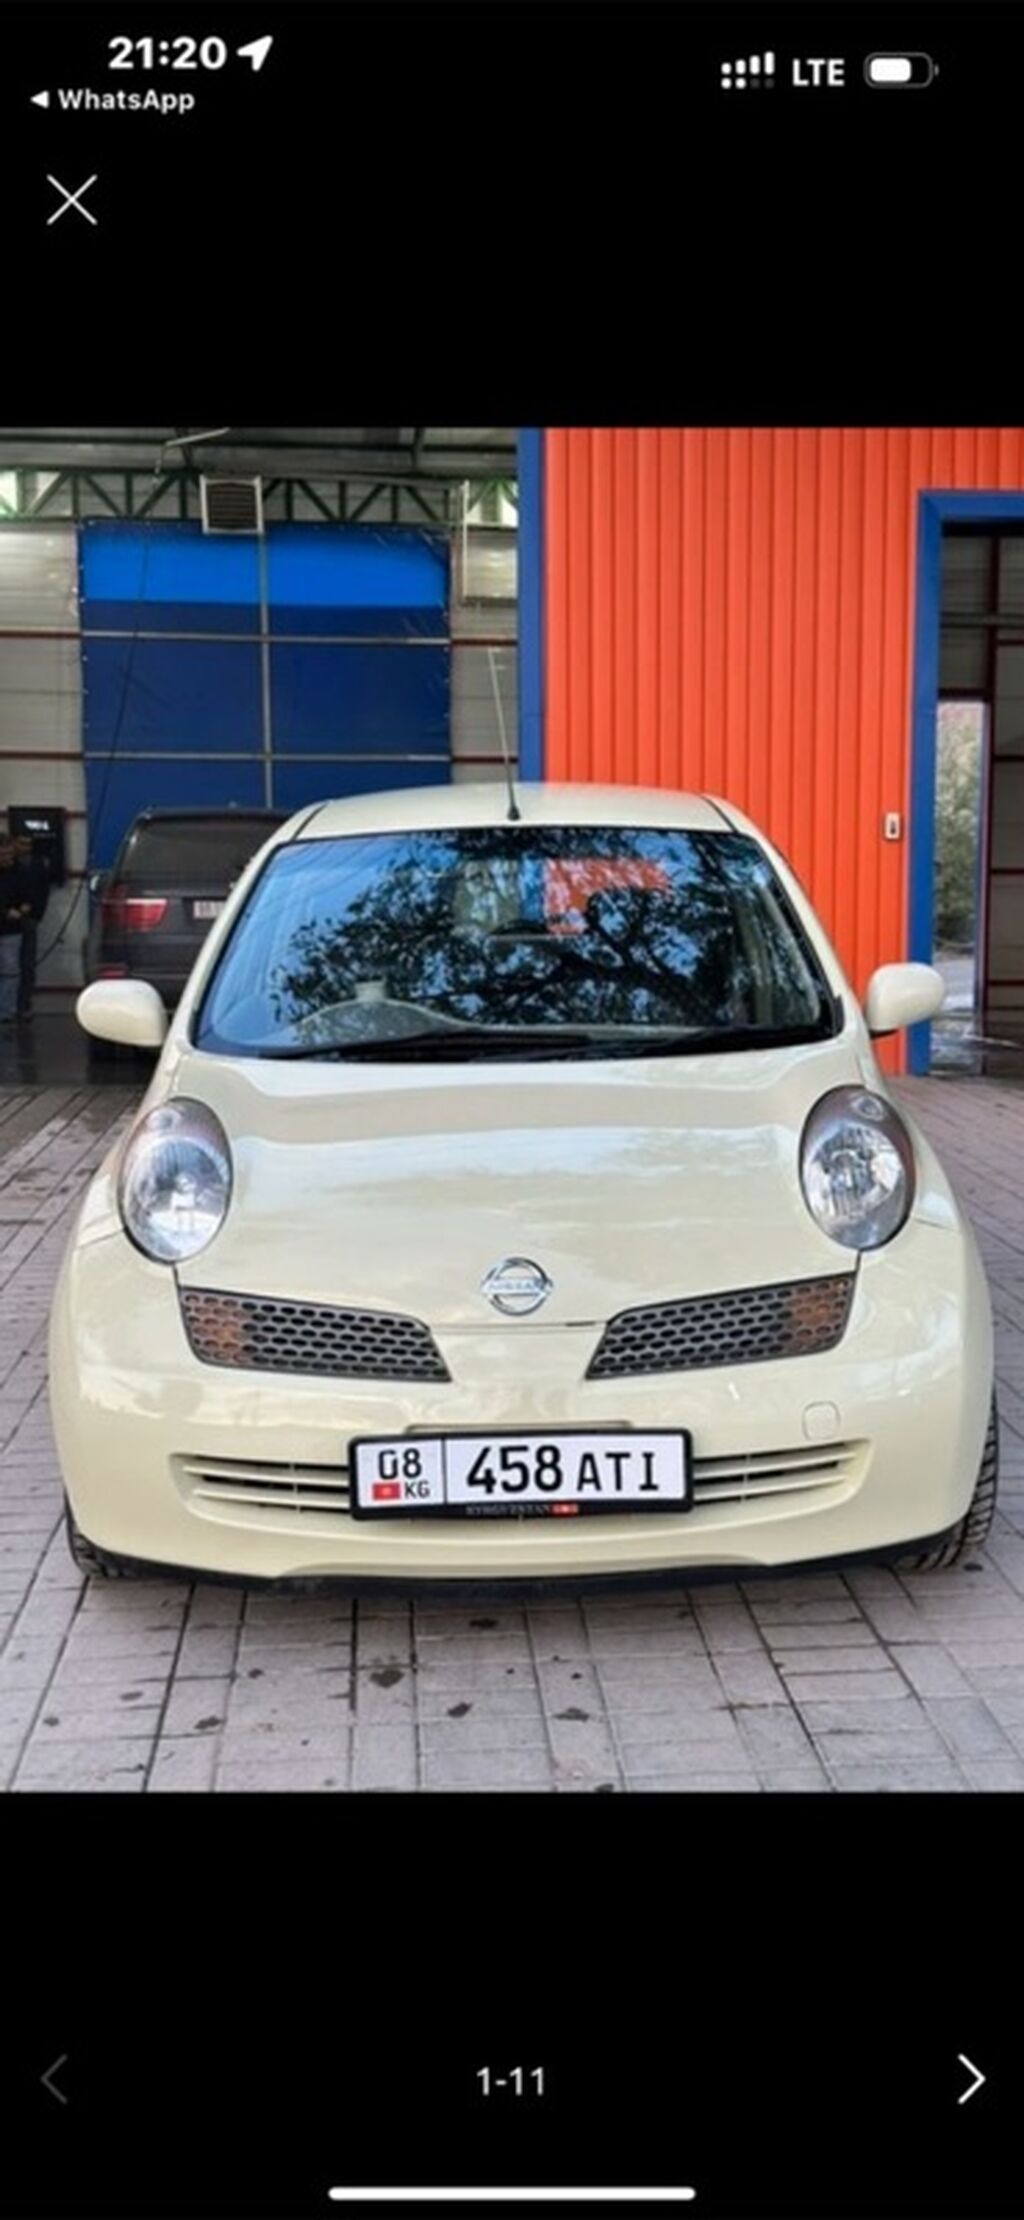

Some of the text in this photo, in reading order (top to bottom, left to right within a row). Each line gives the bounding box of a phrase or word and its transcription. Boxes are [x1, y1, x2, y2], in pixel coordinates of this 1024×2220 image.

[378, 1444, 659, 1495] 08 458 ATI
[404, 1481, 430, 1498] KG
